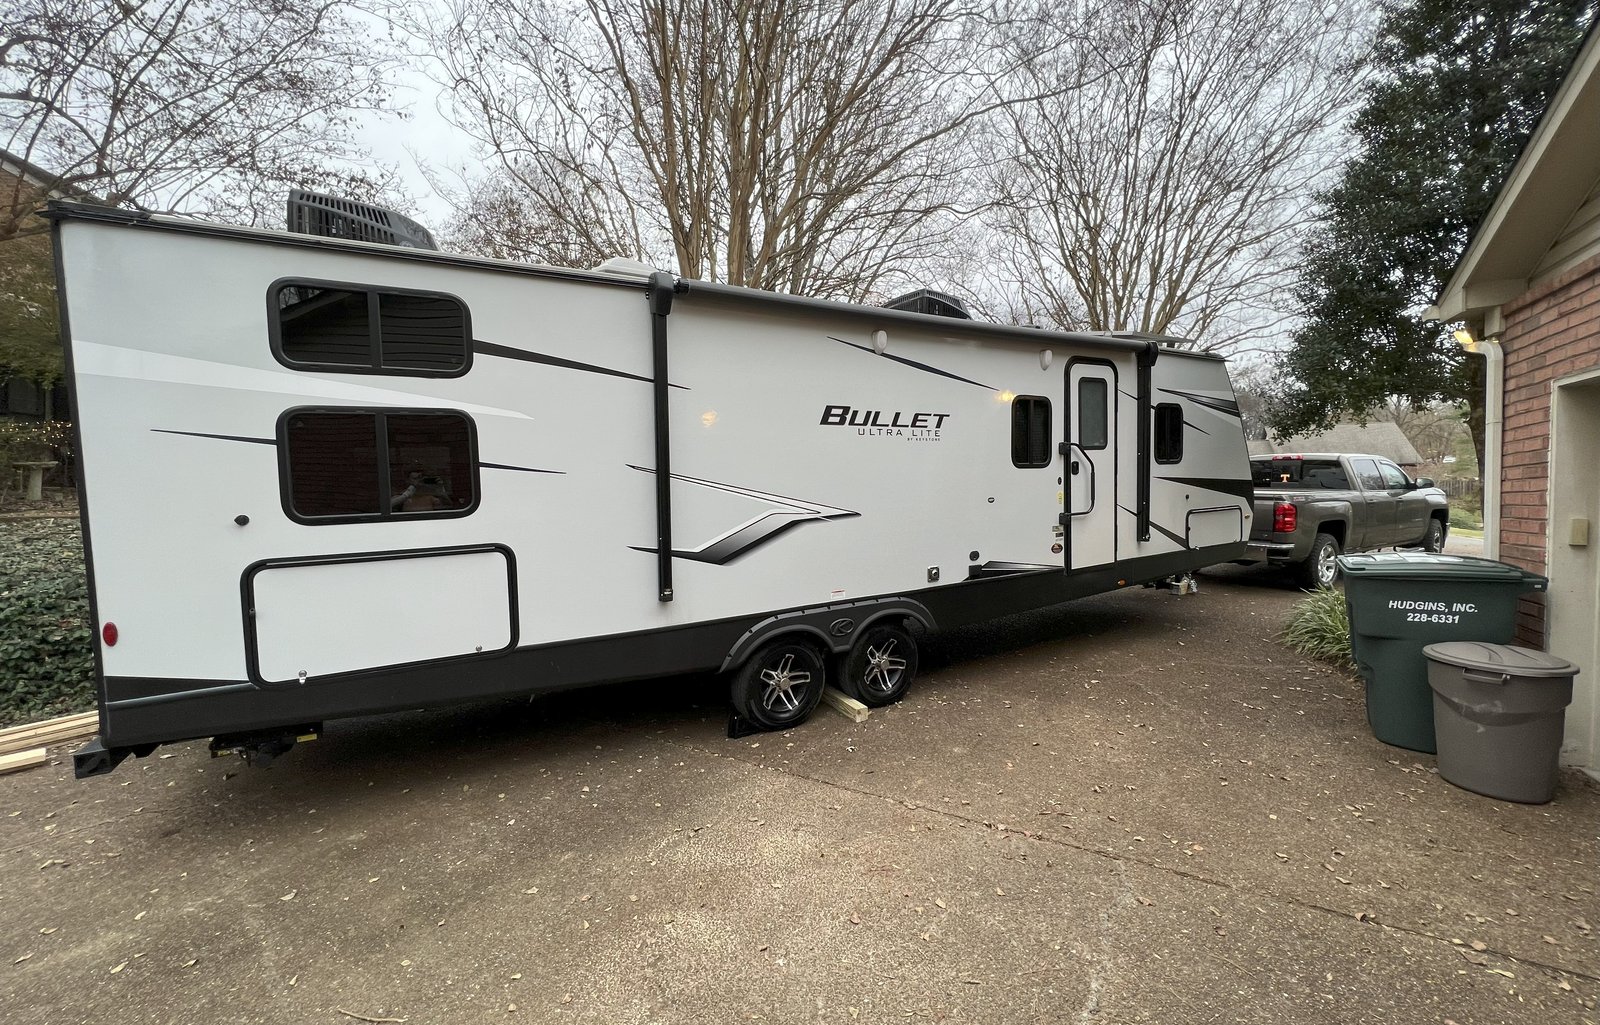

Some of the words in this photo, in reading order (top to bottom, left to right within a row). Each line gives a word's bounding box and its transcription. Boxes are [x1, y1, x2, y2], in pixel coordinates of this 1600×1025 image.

[819, 405, 950, 429] BULLET
[858, 428, 903, 437] ULTRA
[1388, 600, 1449, 613] HUDGINS,
[1452, 603, 1478, 613] INC.
[1406, 612, 1460, 624] 228-6331
